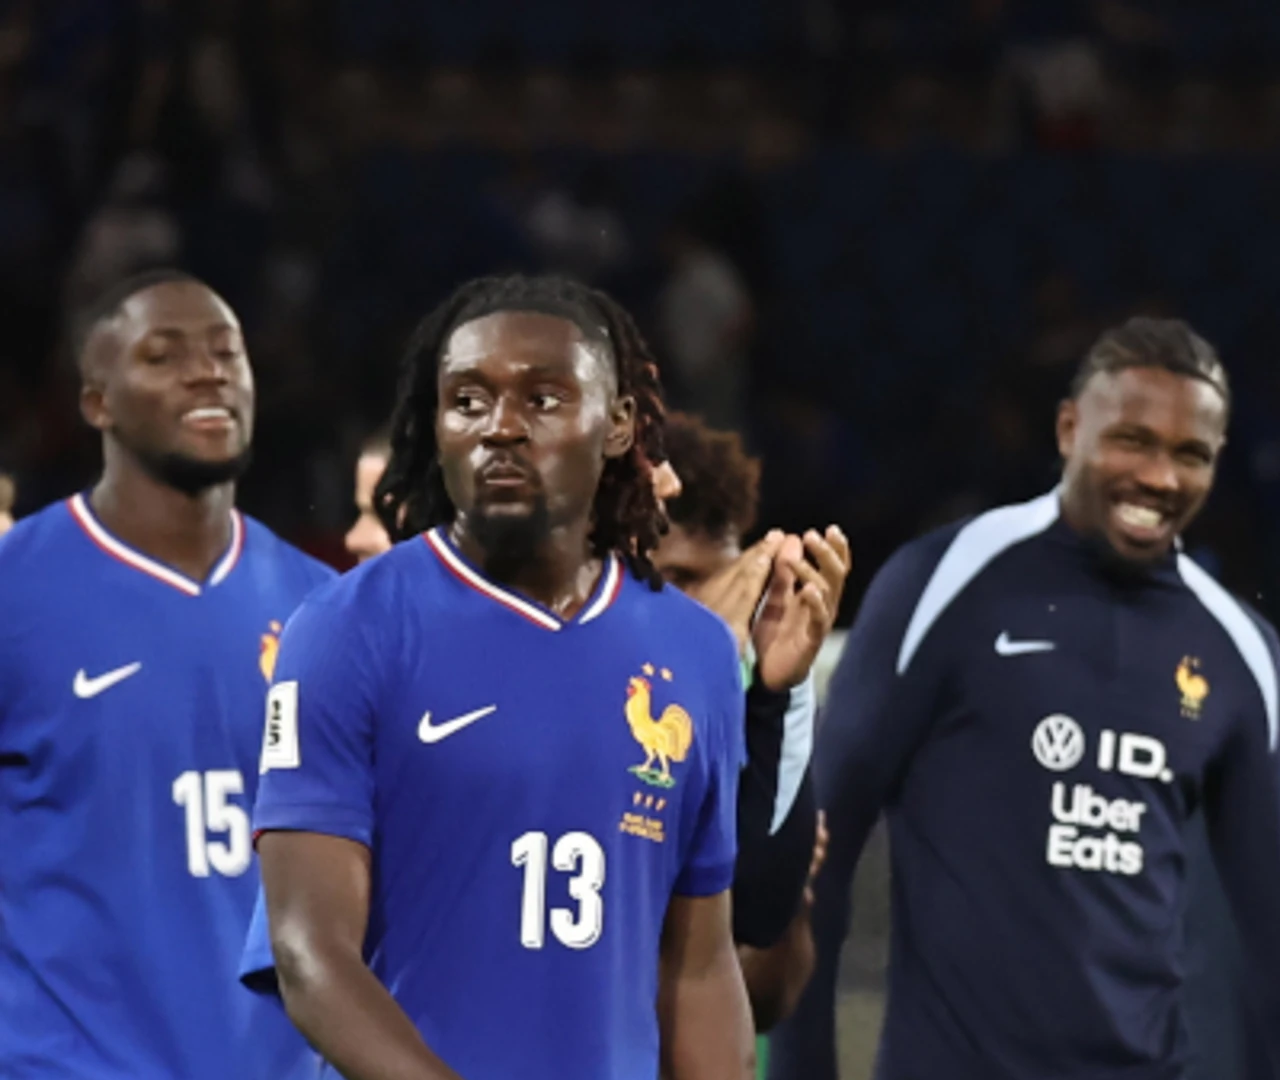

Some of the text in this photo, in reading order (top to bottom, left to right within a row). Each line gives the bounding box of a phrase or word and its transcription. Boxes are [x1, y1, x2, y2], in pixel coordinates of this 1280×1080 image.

[172, 769, 252, 878] 15
[1051, 781, 1147, 833] Uber
[1046, 823, 1144, 875] Eats
[511, 831, 606, 949] 13
